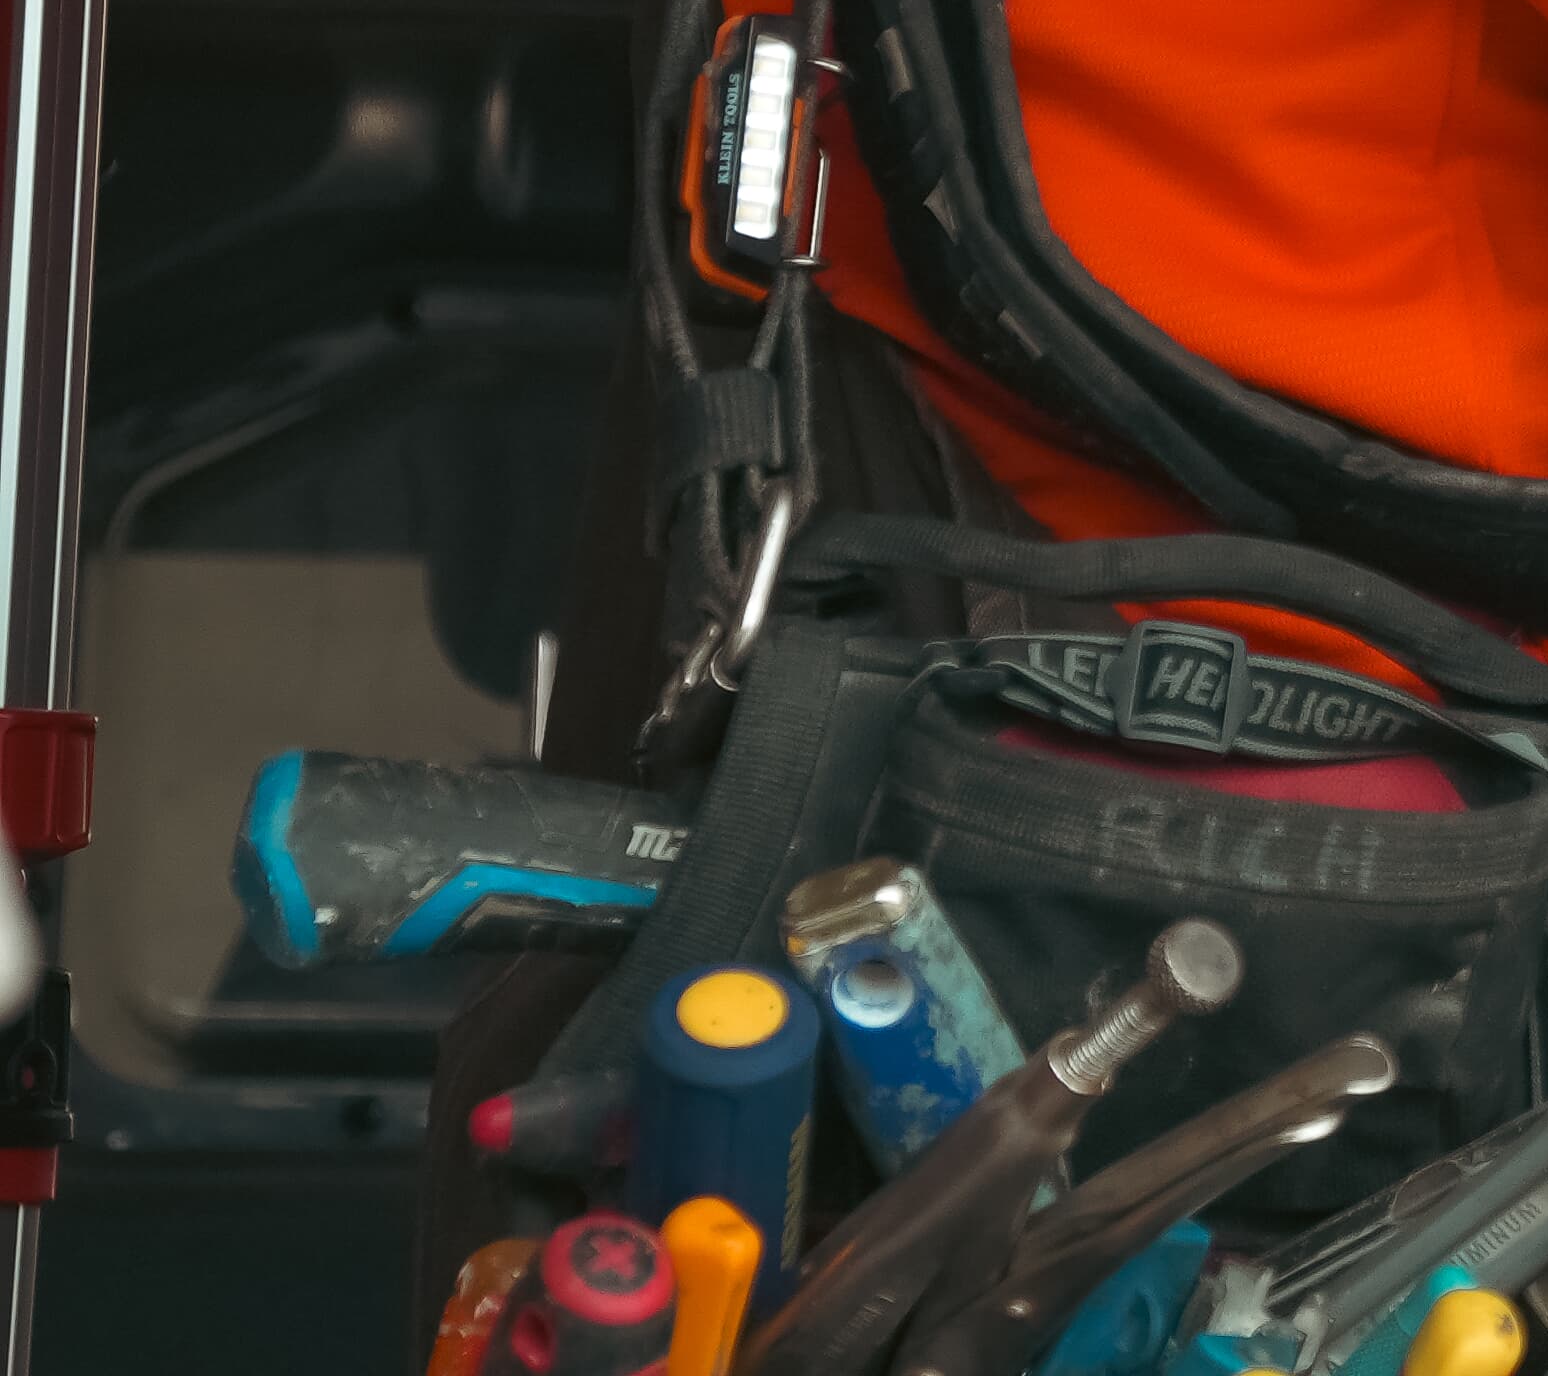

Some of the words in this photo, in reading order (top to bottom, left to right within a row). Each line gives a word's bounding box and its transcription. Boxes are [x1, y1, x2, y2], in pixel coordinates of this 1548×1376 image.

[723, 72, 741, 128] TOOLS
[717, 130, 736, 185] KLEIN
[1146, 653, 1408, 744] HEDLIGHT
